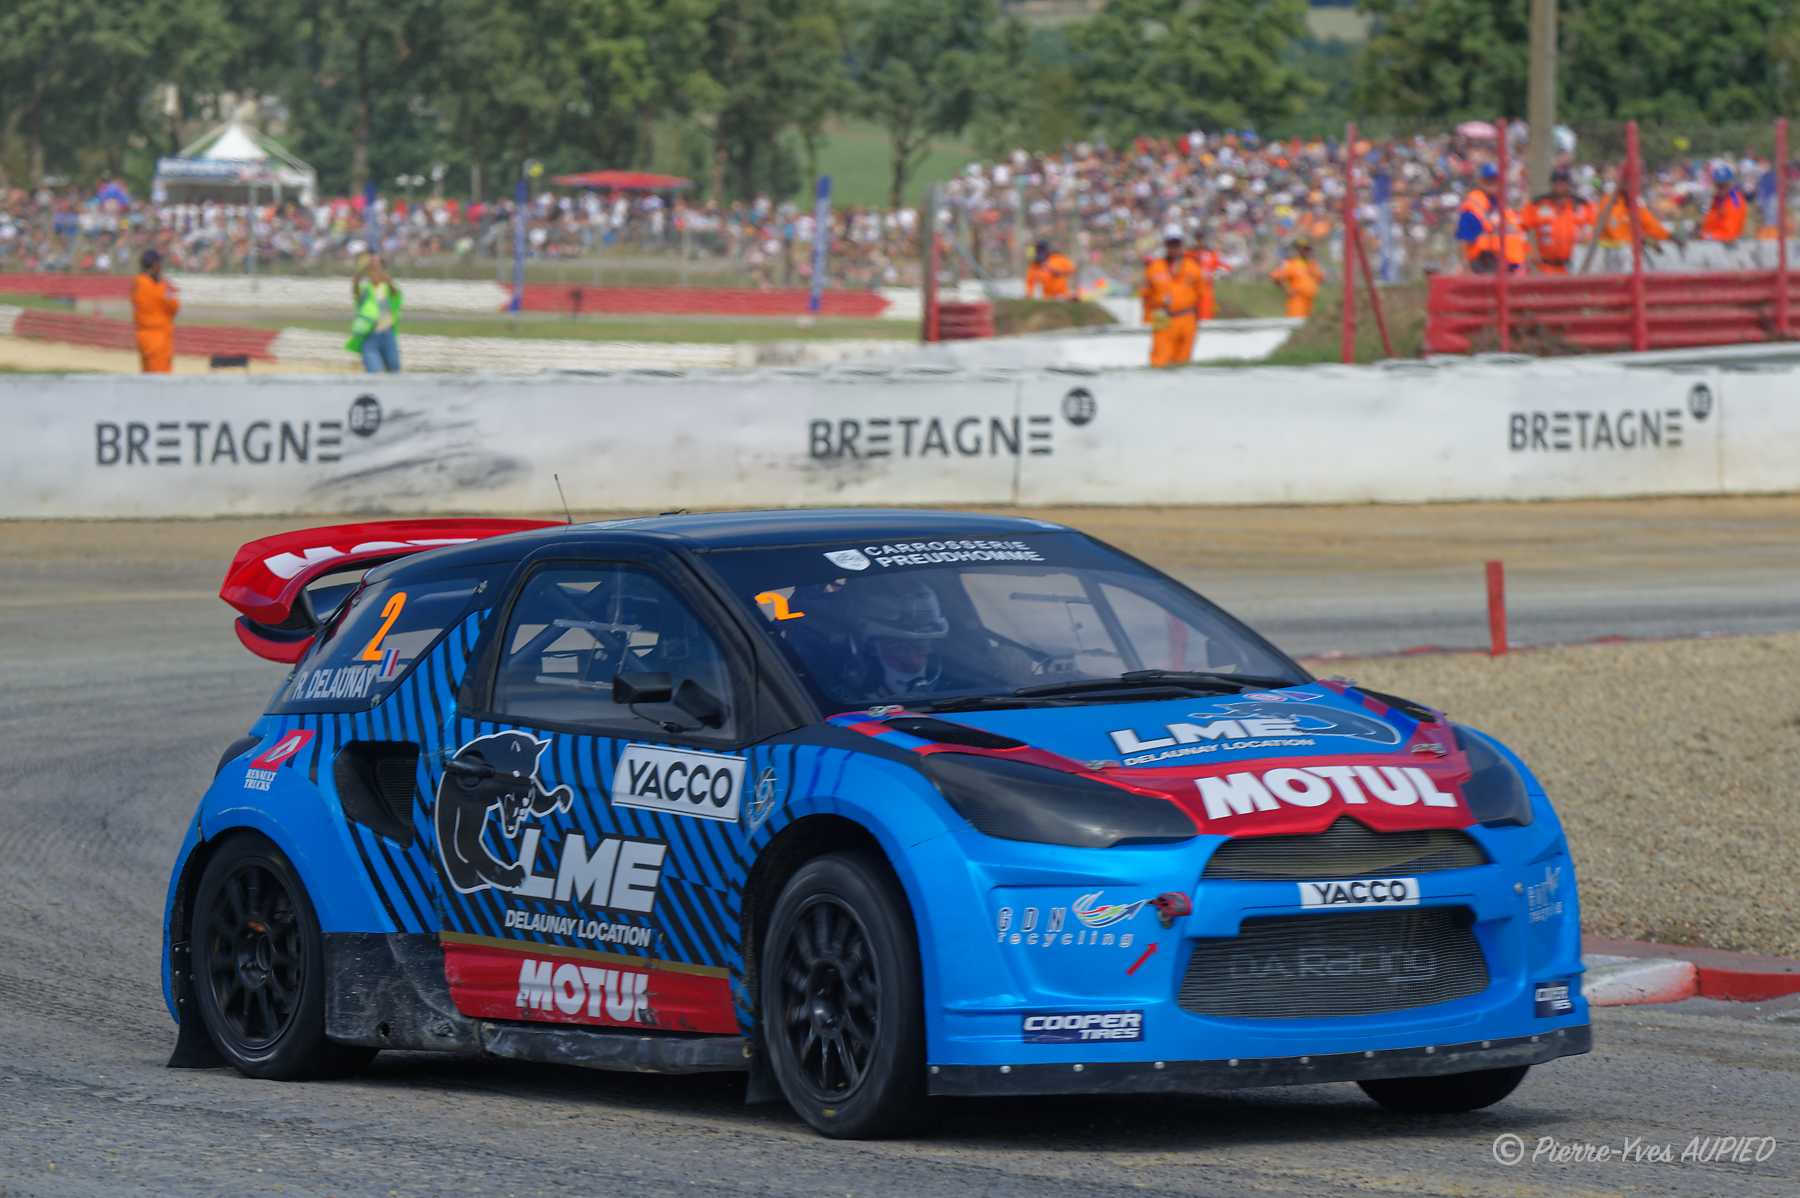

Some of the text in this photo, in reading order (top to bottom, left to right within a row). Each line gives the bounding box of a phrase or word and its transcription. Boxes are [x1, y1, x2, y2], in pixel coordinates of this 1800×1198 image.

[96, 421, 342, 466] BRETAGNE
[809, 415, 1053, 458] BRETAGNE
[1509, 409, 1683, 452] BRETAGNE
[864, 540, 1030, 556] CARROSSERIE
[879, 551, 1046, 568] PREUDHOMME
[754, 592, 805, 620] 2
[361, 592, 407, 661] 2
[306, 668, 376, 700] DELAUNAY
[1110, 718, 1300, 755] LME
[1124, 736, 1317, 767] DELAUNAY LOCATION
[628, 758, 733, 808] YACCO
[1194, 765, 1458, 820] MOTUL
[511, 828, 667, 913] LME
[1314, 880, 1407, 905] YACCO
[505, 909, 652, 948] DELAUNAY LOCATION
[997, 930, 1136, 947] recycling
[1024, 1013, 1143, 1032] COOPER
[1079, 1029, 1140, 1040] TIRES
